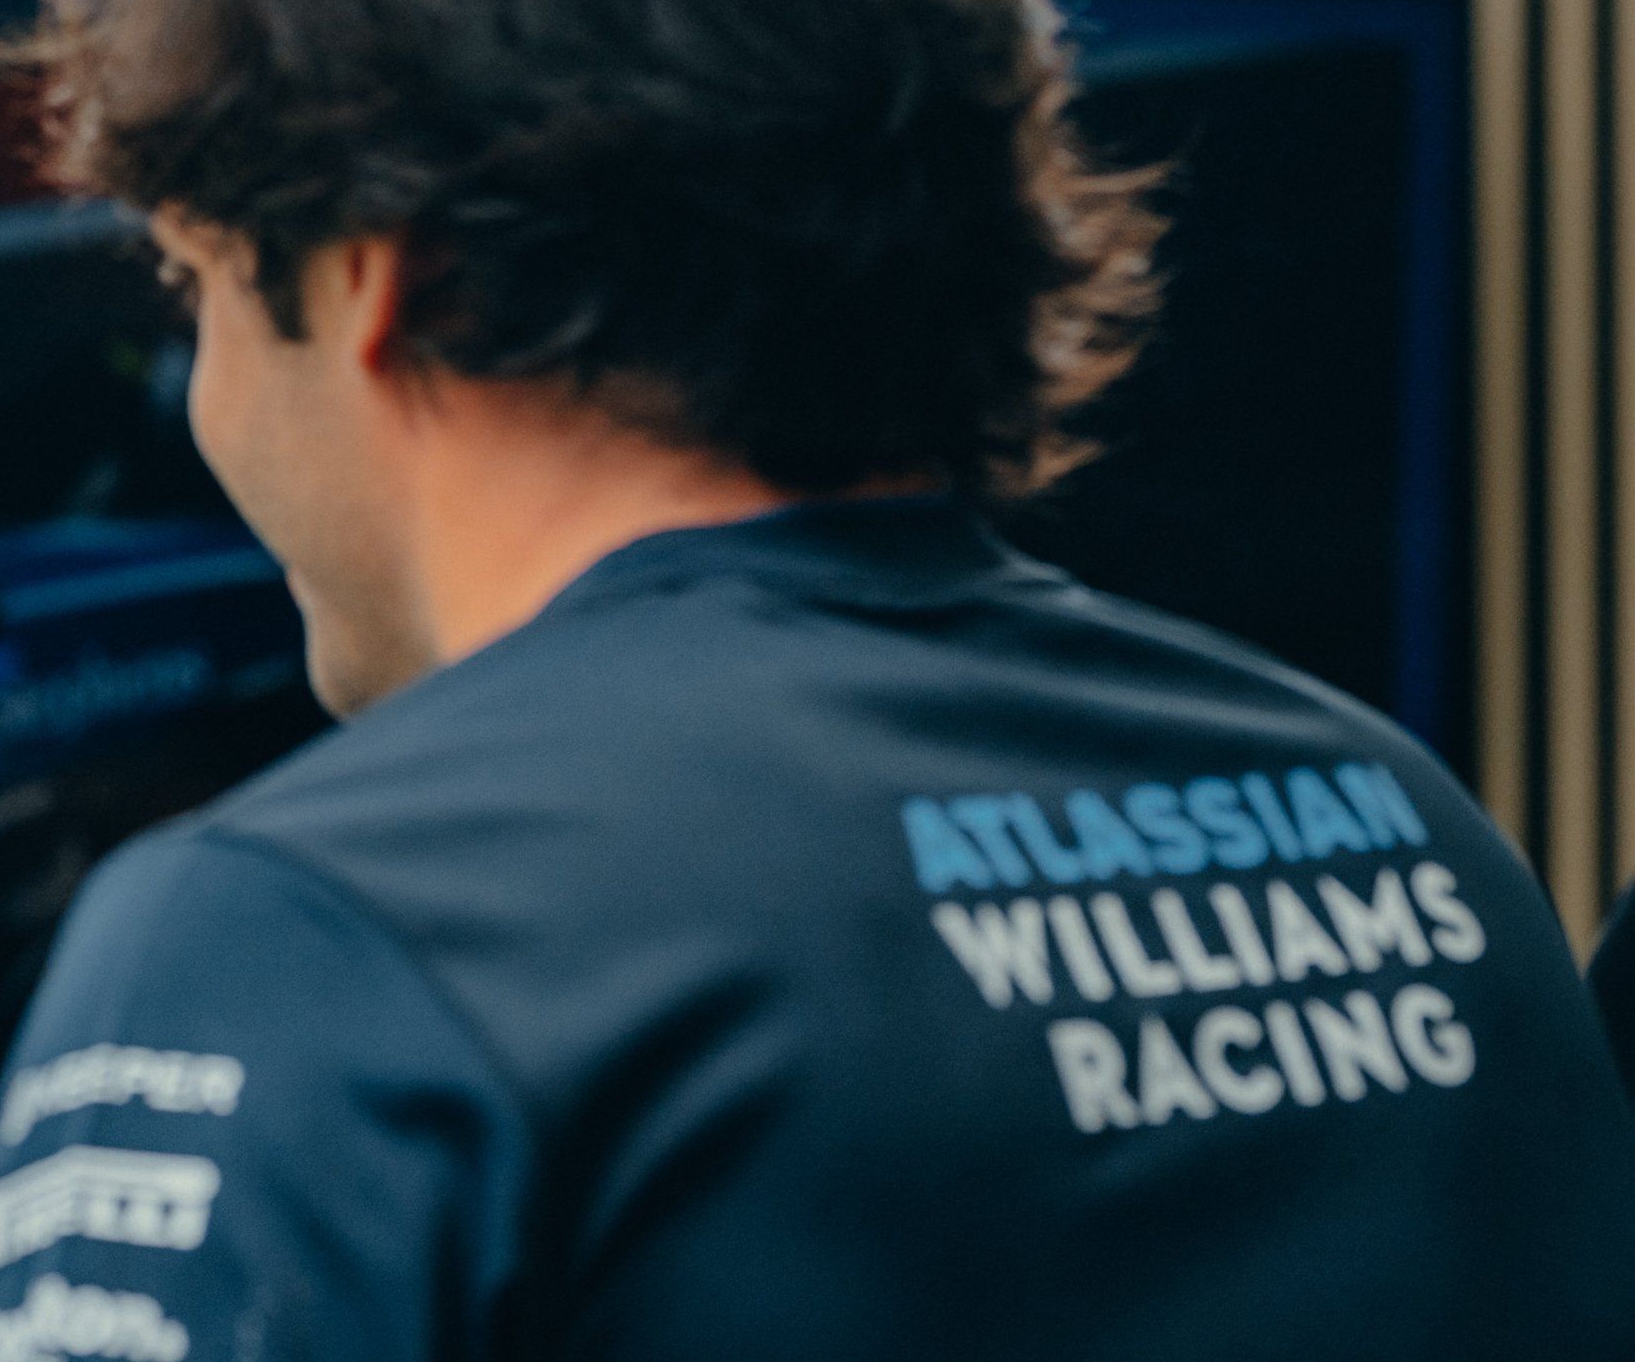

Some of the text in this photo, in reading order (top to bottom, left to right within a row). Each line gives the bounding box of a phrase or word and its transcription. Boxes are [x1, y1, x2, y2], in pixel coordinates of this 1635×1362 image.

[902, 763, 1428, 894] ATLASSIAN
[931, 861, 1486, 1009] WILLIAMS
[1047, 983, 1476, 1133] RACING
